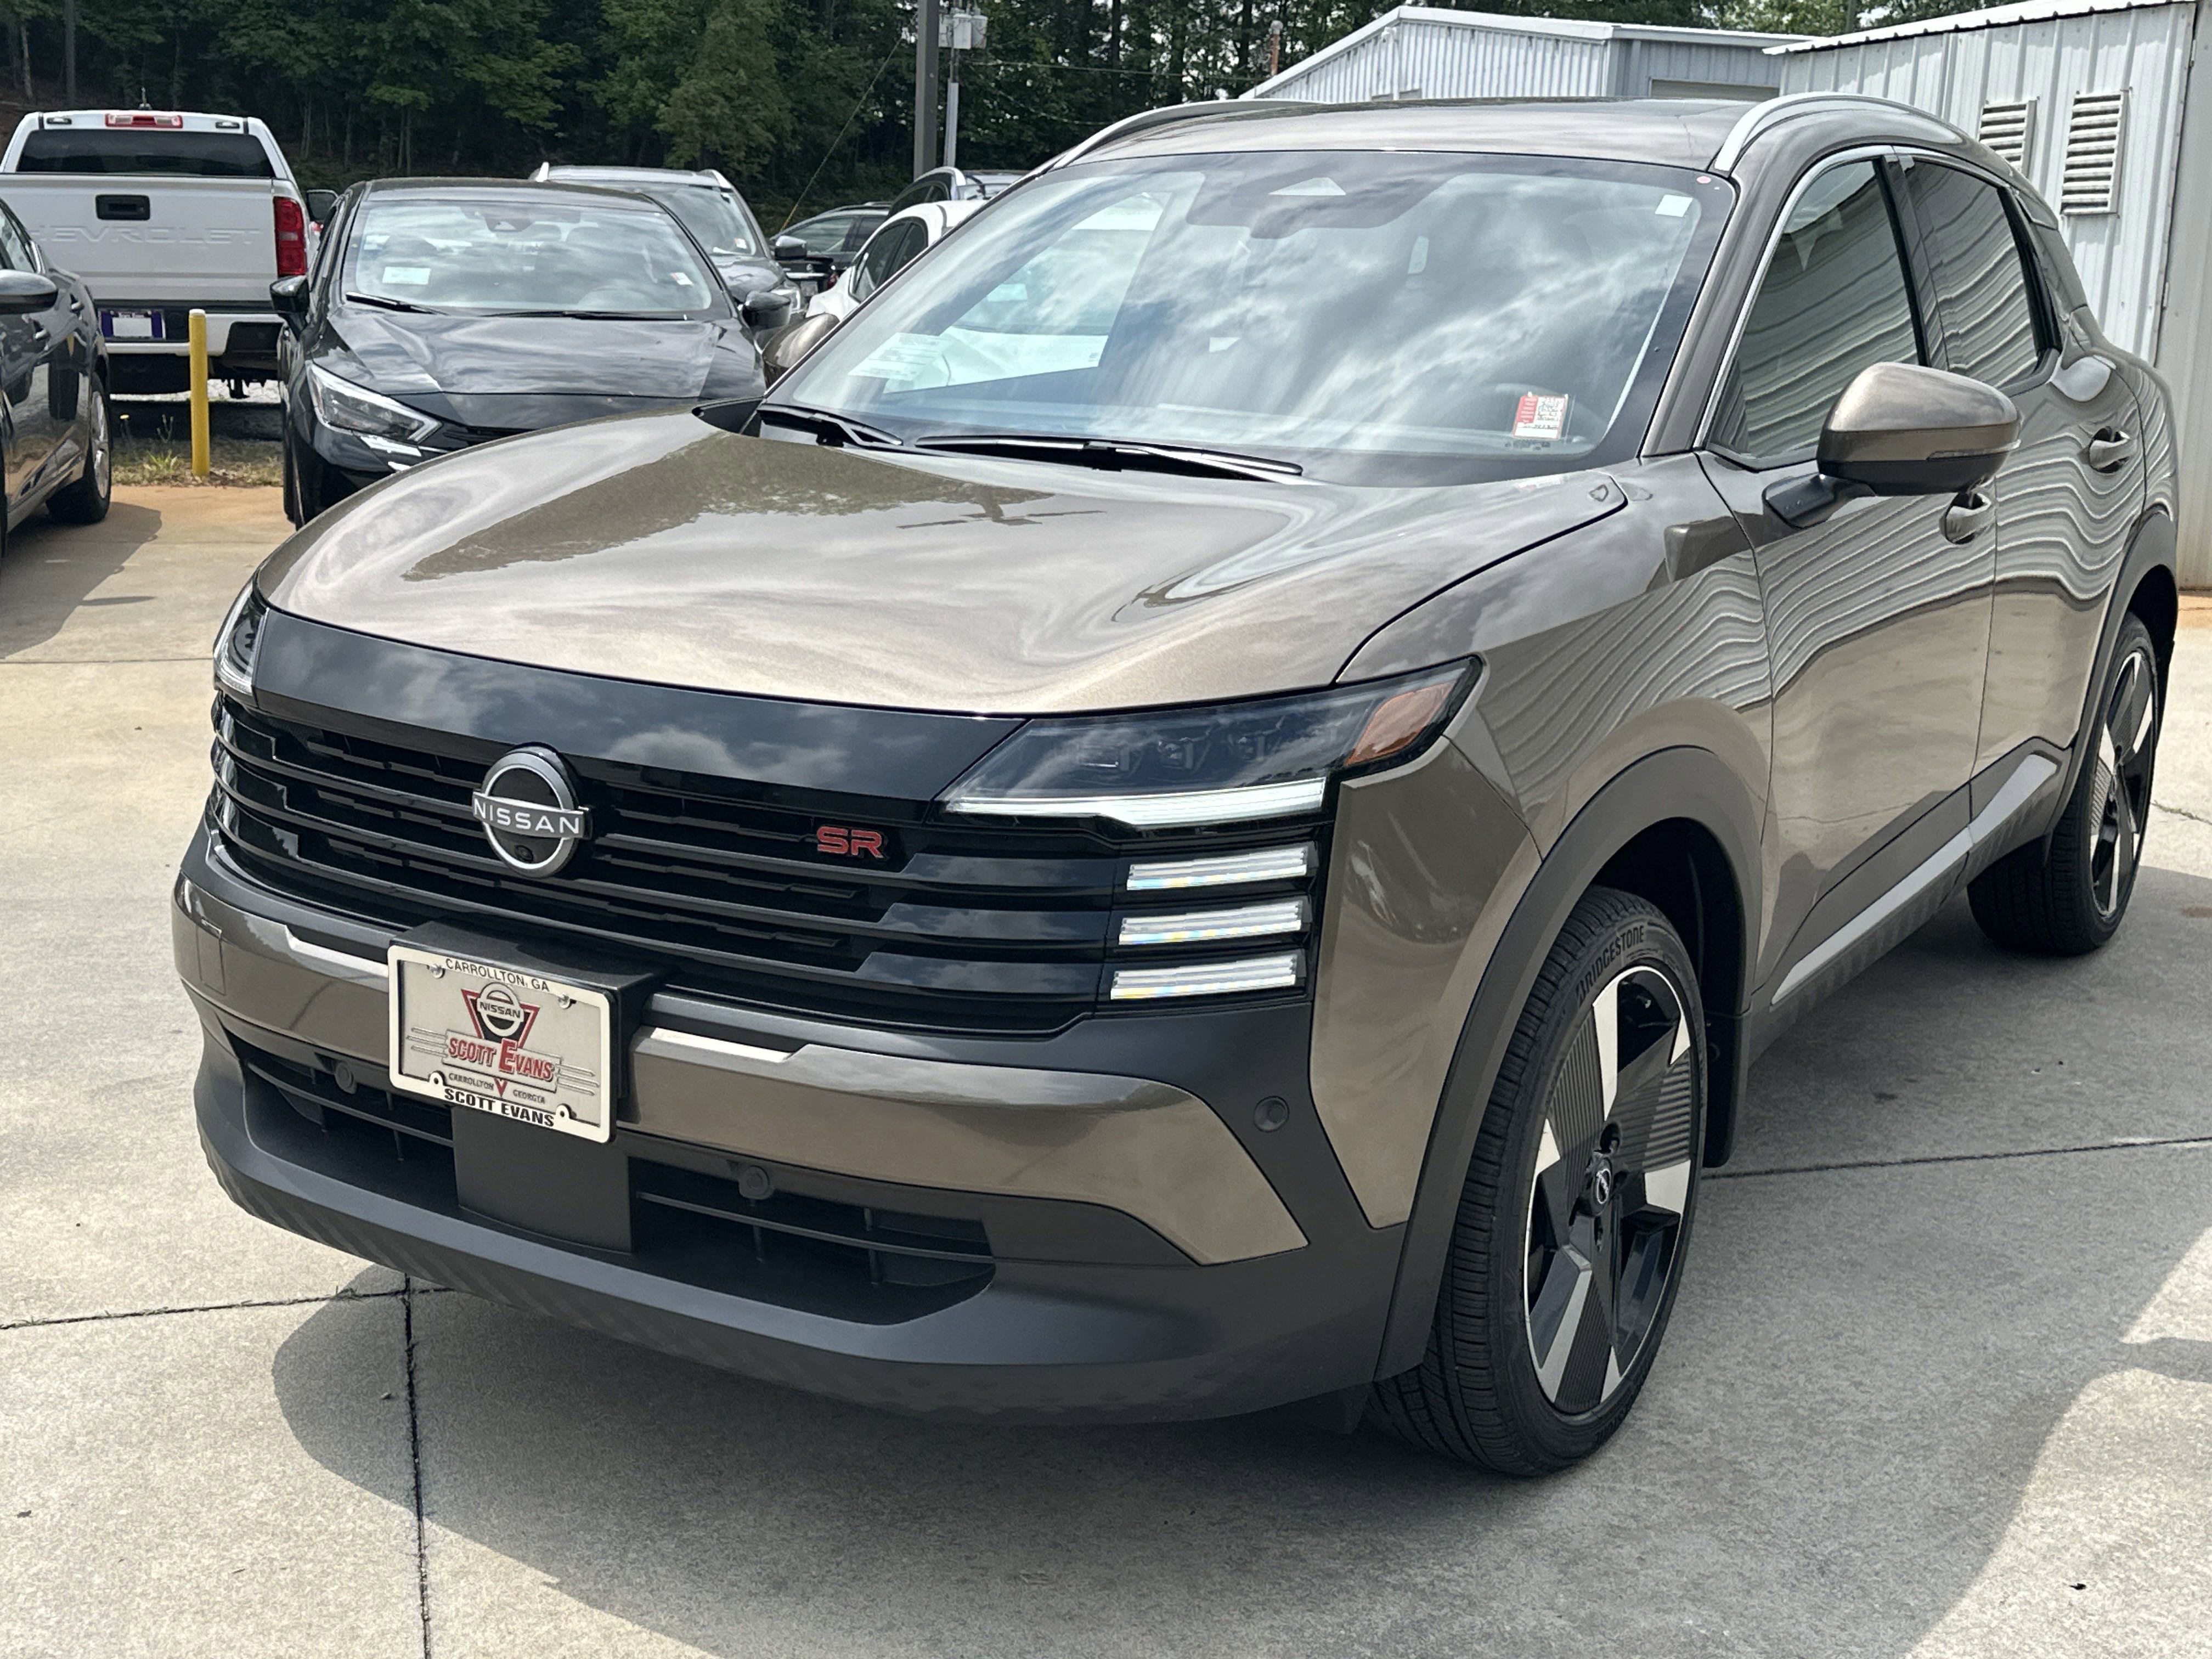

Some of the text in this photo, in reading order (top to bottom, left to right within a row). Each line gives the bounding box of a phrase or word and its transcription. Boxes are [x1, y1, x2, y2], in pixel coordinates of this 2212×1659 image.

[30, 225, 260, 245] HEVROLET
[473, 798, 580, 834] NISSAN
[816, 826, 884, 859] SR
[445, 958, 550, 992] CARROLLTON, GA
[1576, 925, 1645, 1008] BRIDGESTONE
[479, 1001, 521, 1019] NISSAN
[448, 1037, 496, 1068] SCOTT
[448, 1073, 546, 1104] CARROLLTON GEORGIA
[444, 1088, 555, 1127] SCOTT EVANS
